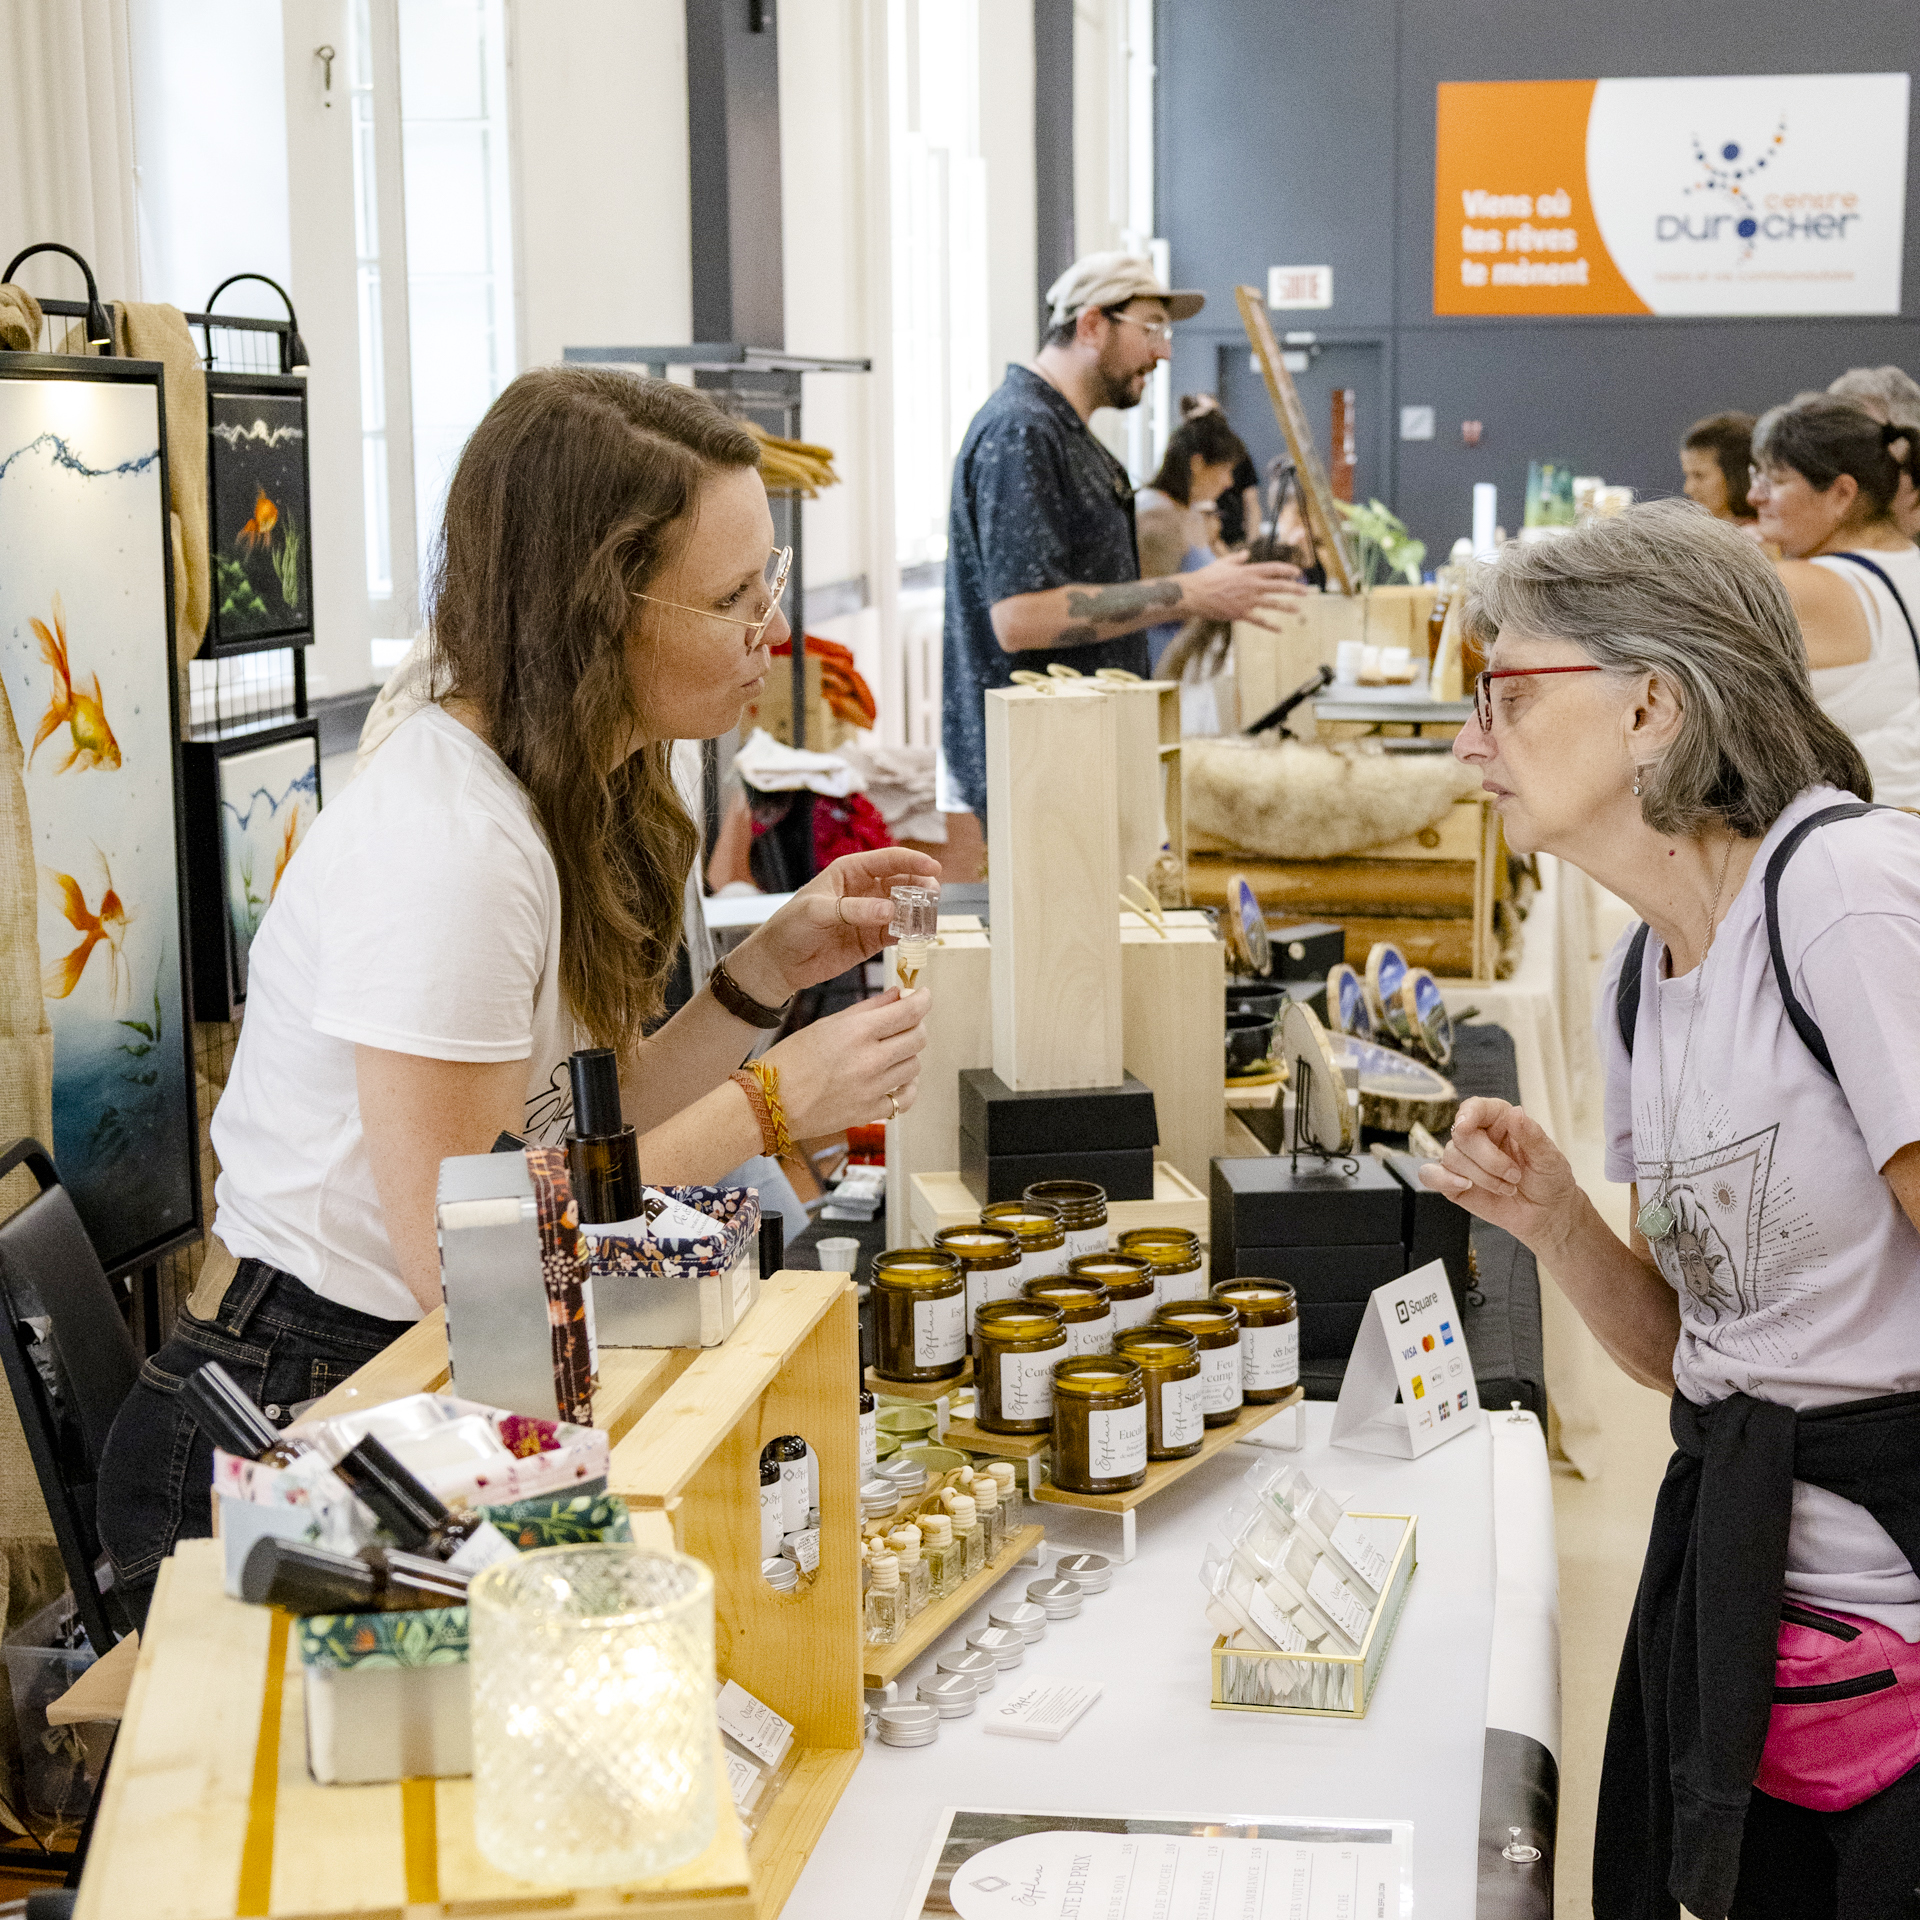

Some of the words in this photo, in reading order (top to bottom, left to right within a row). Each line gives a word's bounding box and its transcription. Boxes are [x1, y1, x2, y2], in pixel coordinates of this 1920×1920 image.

[1462, 189, 1534, 218] Viens
[1535, 187, 1572, 218] où
[1461, 224, 1503, 253] tes
[1461, 258, 1488, 287] te
[1408, 1292, 1438, 1317] Square
[1216, 1360, 1233, 1371] Feu
[1401, 1346, 1418, 1360] VISA
[1206, 1371, 1233, 1384] camp
[740, 1697, 758, 1719] Quartz
[1075, 1854, 1092, 1877] PRIX
[1158, 1863, 1173, 1891] DOUCHE
[1067, 1879, 1085, 1895] DE
[1200, 1870, 1215, 1909] PARFUMÉS
[1245, 1866, 1260, 1911] D'AMBIANCE
[1293, 1868, 1305, 1903] VOITURE
[1338, 1893, 1349, 1911] CIRE
